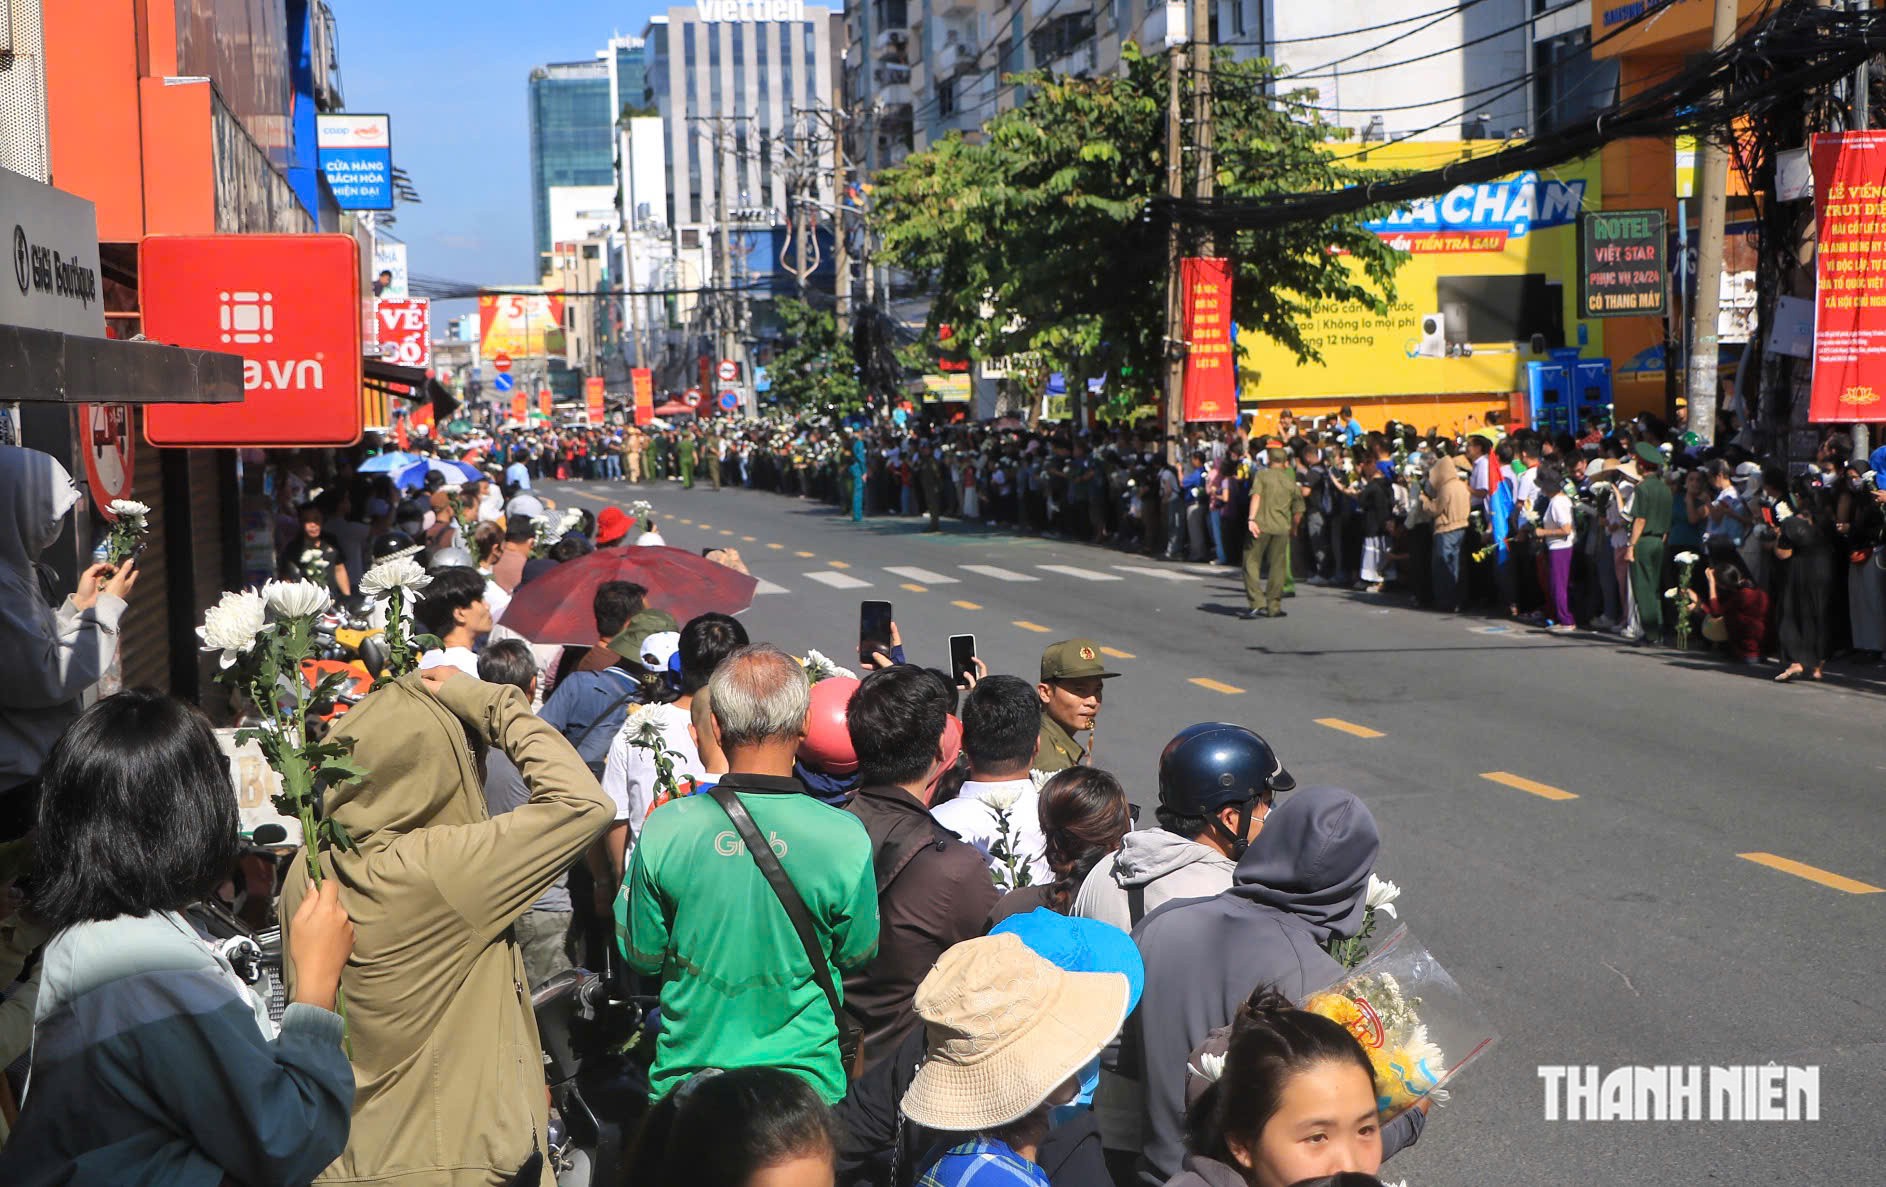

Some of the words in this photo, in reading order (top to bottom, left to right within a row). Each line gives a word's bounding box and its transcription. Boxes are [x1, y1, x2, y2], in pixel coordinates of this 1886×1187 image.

[1441, 172, 1583, 234] CHẬM
[1594, 217, 1653, 240] HOTEL
[1472, 238, 1499, 249] SAU
[1624, 245, 1655, 261] STAR
[54, 250, 96, 310] Boutique
[1589, 271, 1616, 287] PHỤC
[1633, 270, 1660, 284] 24/24
[1589, 292, 1604, 310] CÓ
[1605, 293, 1637, 309] THANG
[1639, 290, 1661, 308] MÁY
[381, 304, 424, 330] VÉ
[1322, 318, 1359, 331] Không
[1362, 317, 1372, 329] lo
[1375, 317, 1396, 331] mọi
[1398, 315, 1416, 330] phí
[382, 332, 422, 362] SỐ
[1327, 335, 1337, 346] 12
[1341, 334, 1374, 347] tháng
[714, 830, 788, 859] Grb
